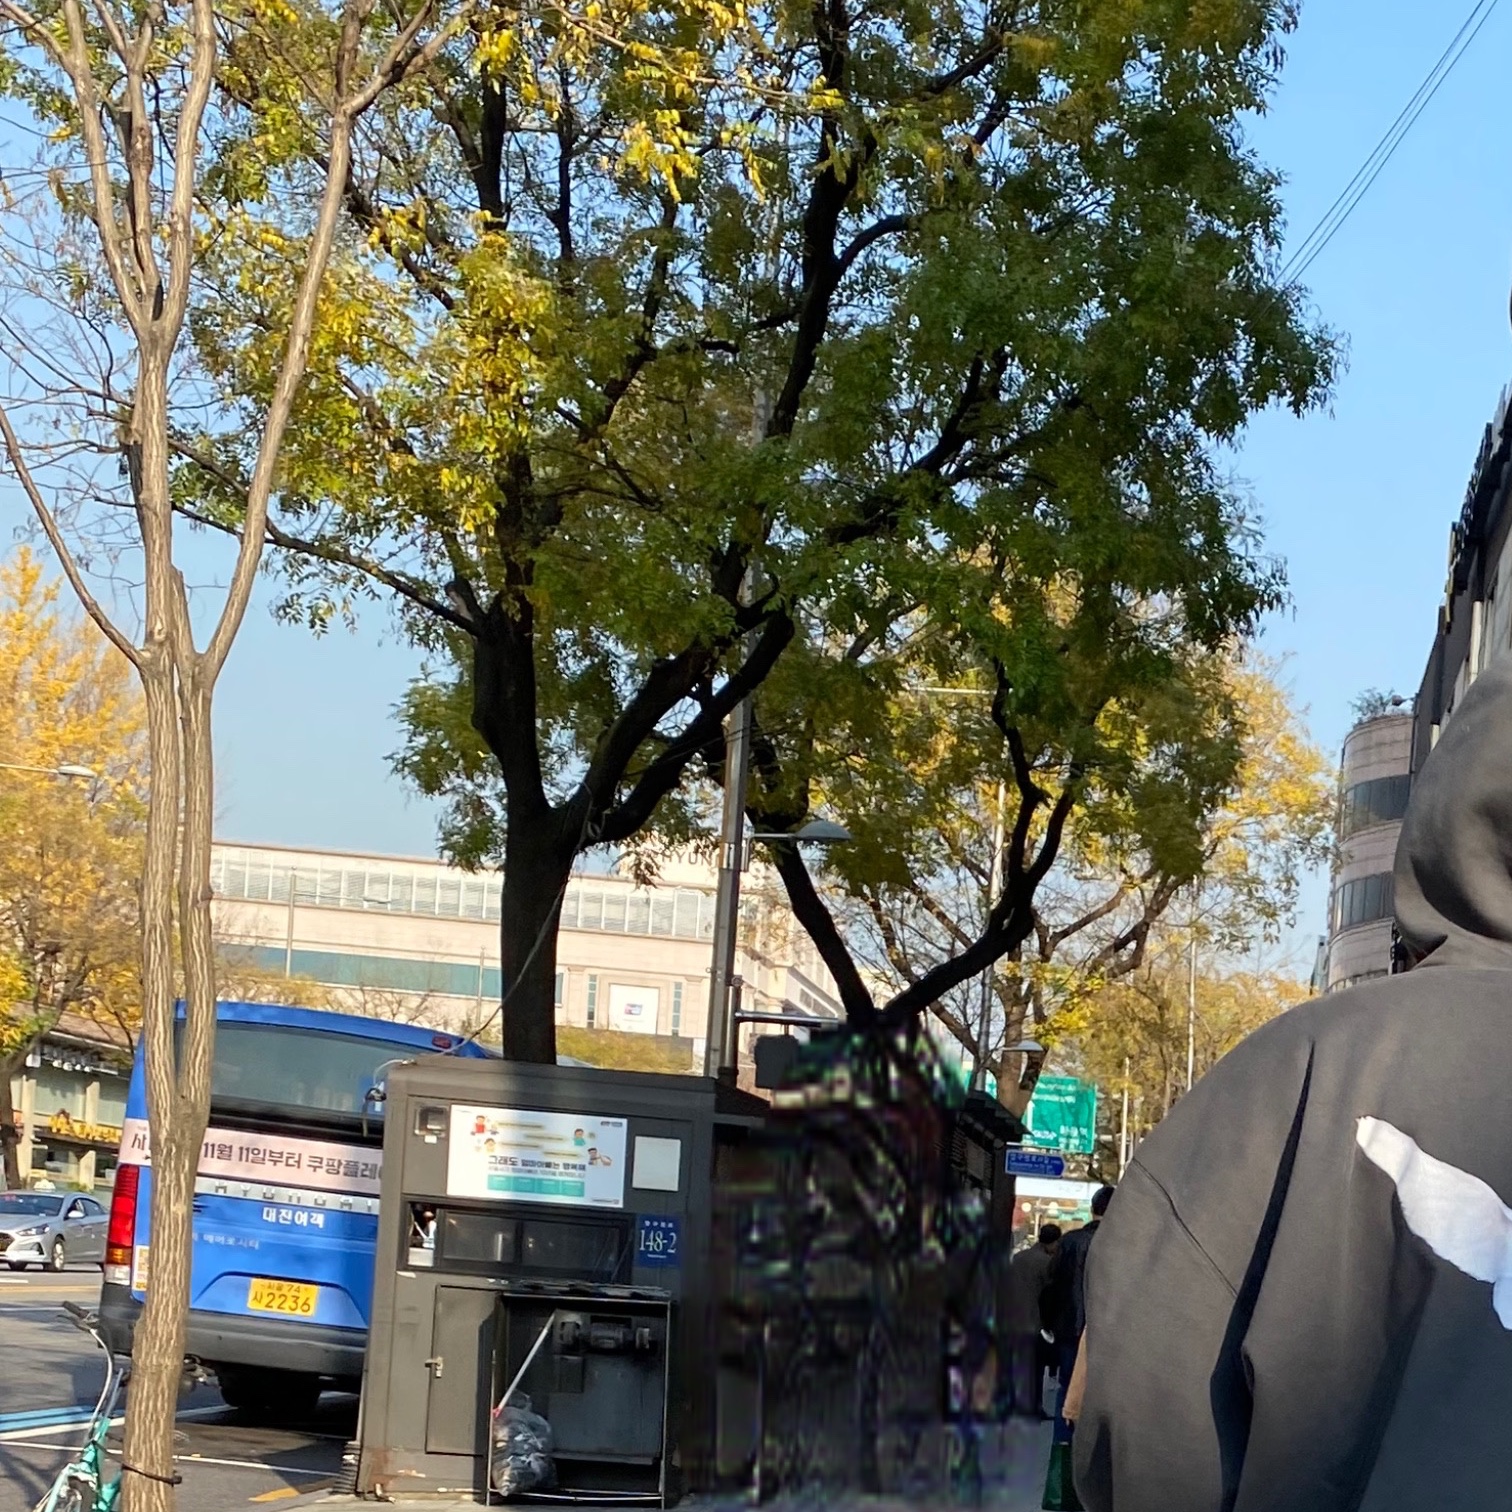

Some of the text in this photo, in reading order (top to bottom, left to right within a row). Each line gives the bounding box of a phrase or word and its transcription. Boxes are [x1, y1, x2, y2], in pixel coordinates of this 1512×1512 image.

[661, 851, 716, 867] HYUN
[203, 1142, 233, 1161] 11월
[238, 1146, 302, 1169] 11일부터
[215, 1181, 373, 1213] HYUNDAI
[263, 1206, 325, 1229] 대진여객
[640, 1229, 677, 1253] 148-2
